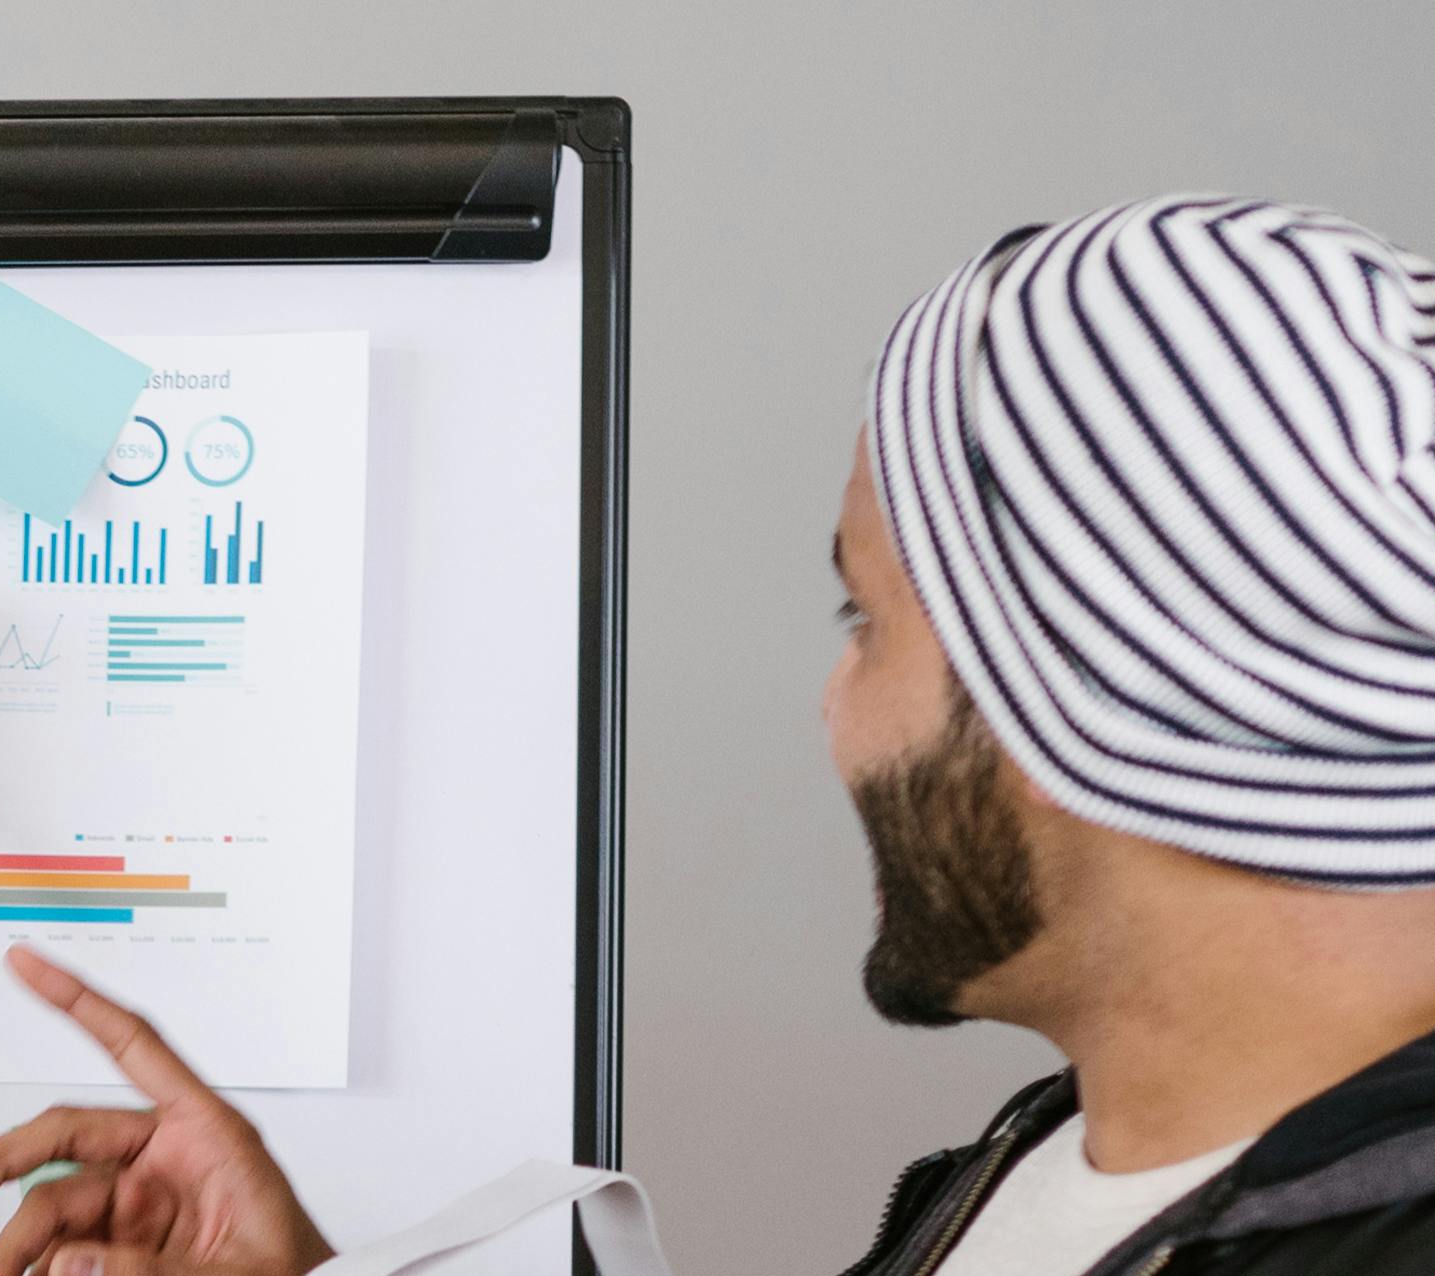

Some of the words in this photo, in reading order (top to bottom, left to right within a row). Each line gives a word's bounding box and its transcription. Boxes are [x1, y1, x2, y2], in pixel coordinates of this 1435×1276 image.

[141, 369, 231, 390] shboard
[115, 443, 155, 460] 65%
[203, 443, 241, 460] 75%
